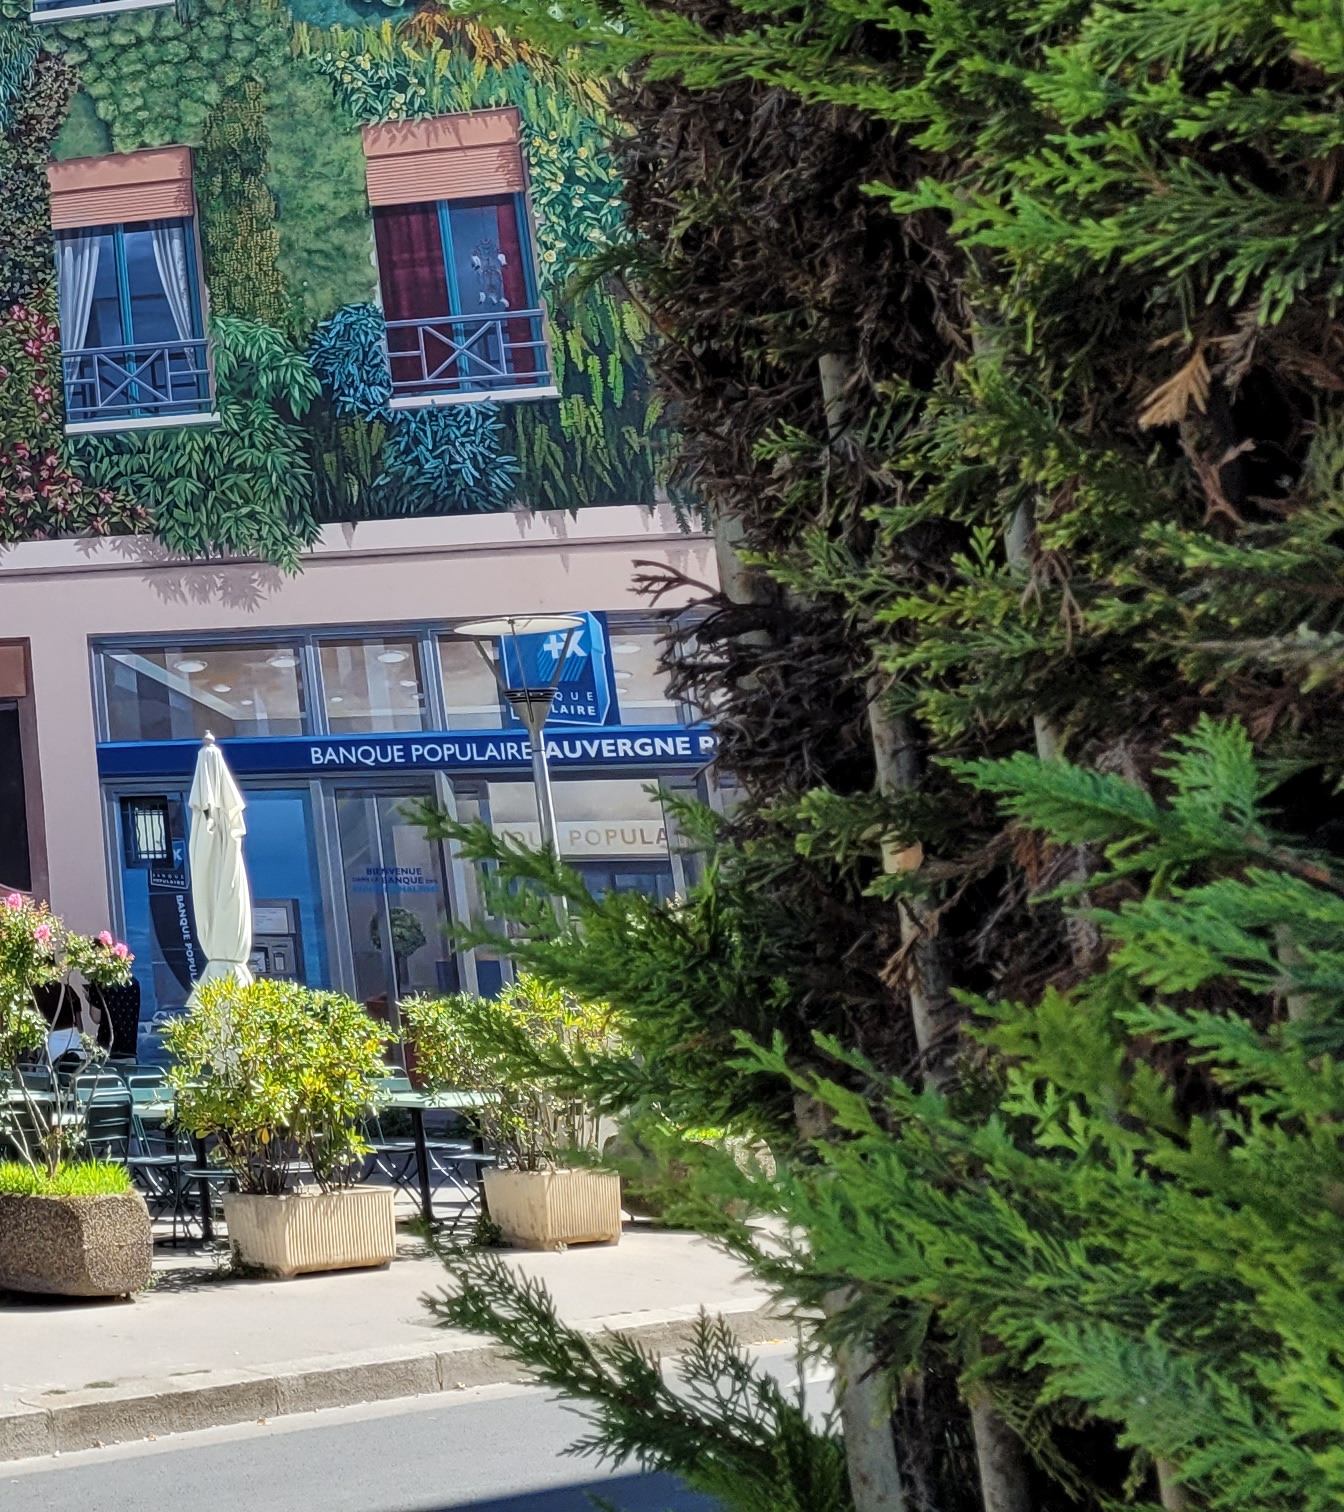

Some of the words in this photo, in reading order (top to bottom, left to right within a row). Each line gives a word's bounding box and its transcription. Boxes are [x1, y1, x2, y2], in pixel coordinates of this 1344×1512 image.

[554, 691, 594, 701] QUE
[551, 704, 597, 716] LAIRE
[310, 744, 406, 767] BANQUE
[411, 741, 532, 763] POPULAIRE
[545, 736, 692, 760] AUVERGNE
[569, 827, 667, 846] POPULA
[176, 894, 191, 940] BANQUE
[184, 943, 199, 980] POPUL
